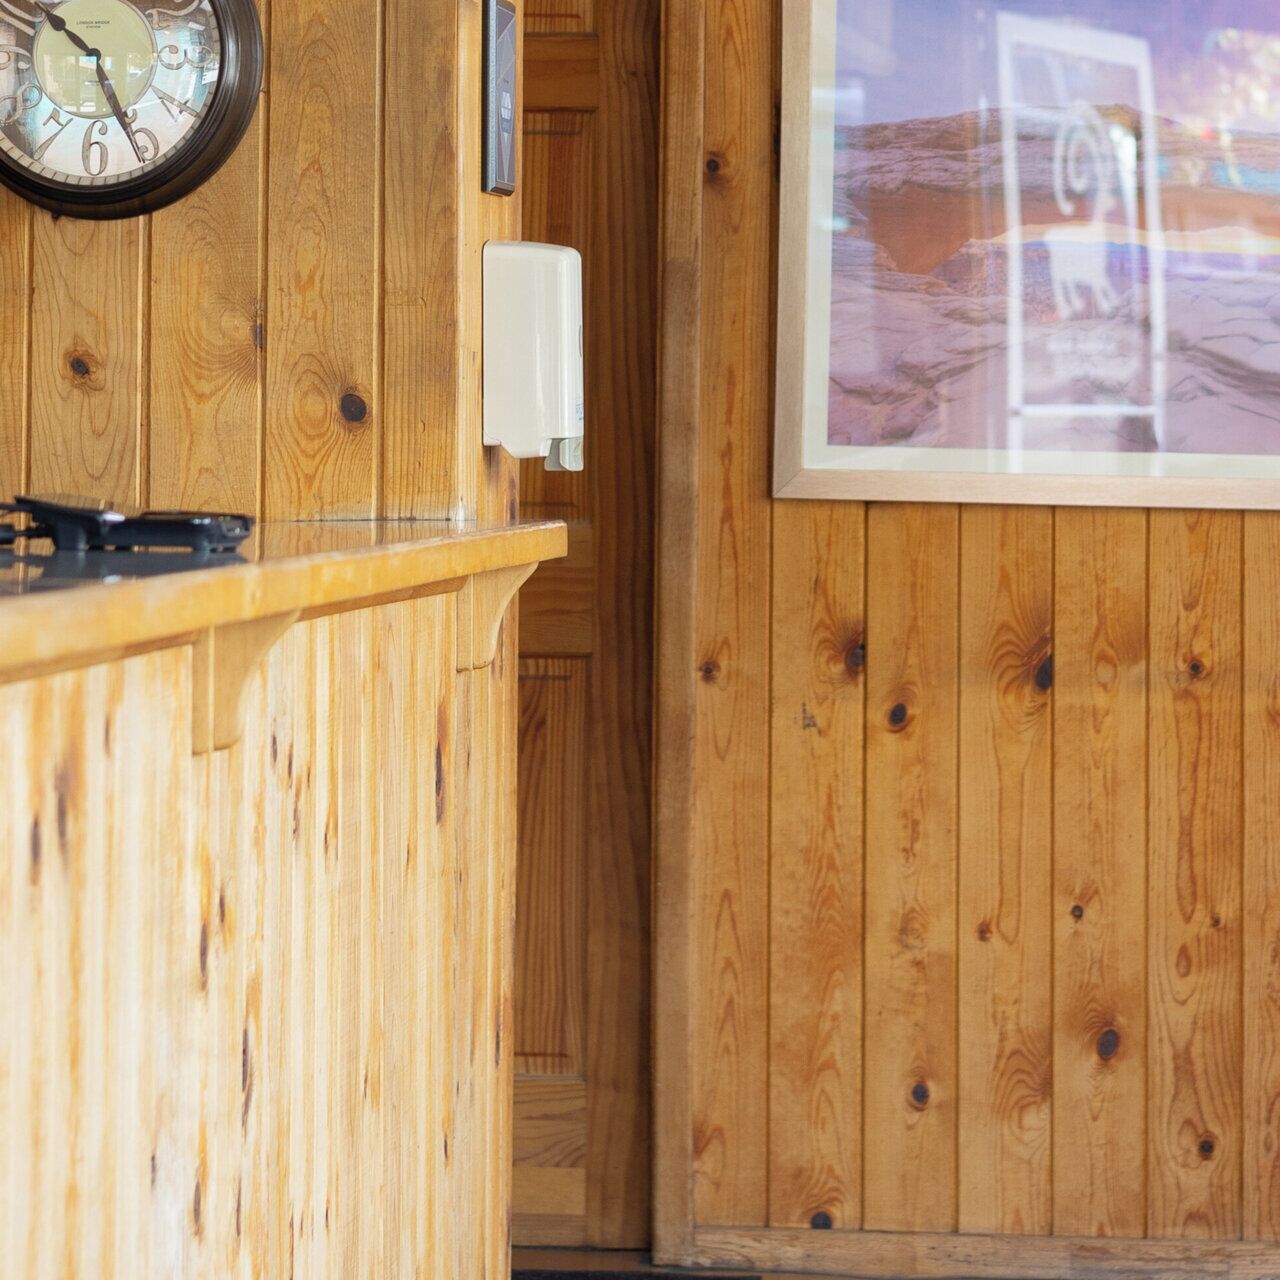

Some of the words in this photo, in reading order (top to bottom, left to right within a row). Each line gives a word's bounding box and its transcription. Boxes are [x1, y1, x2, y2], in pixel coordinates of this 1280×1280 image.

[158, 44, 213, 69] 3
[151, 85, 199, 122] 4
[34, 108, 73, 160] 7
[81, 120, 108, 176] 6
